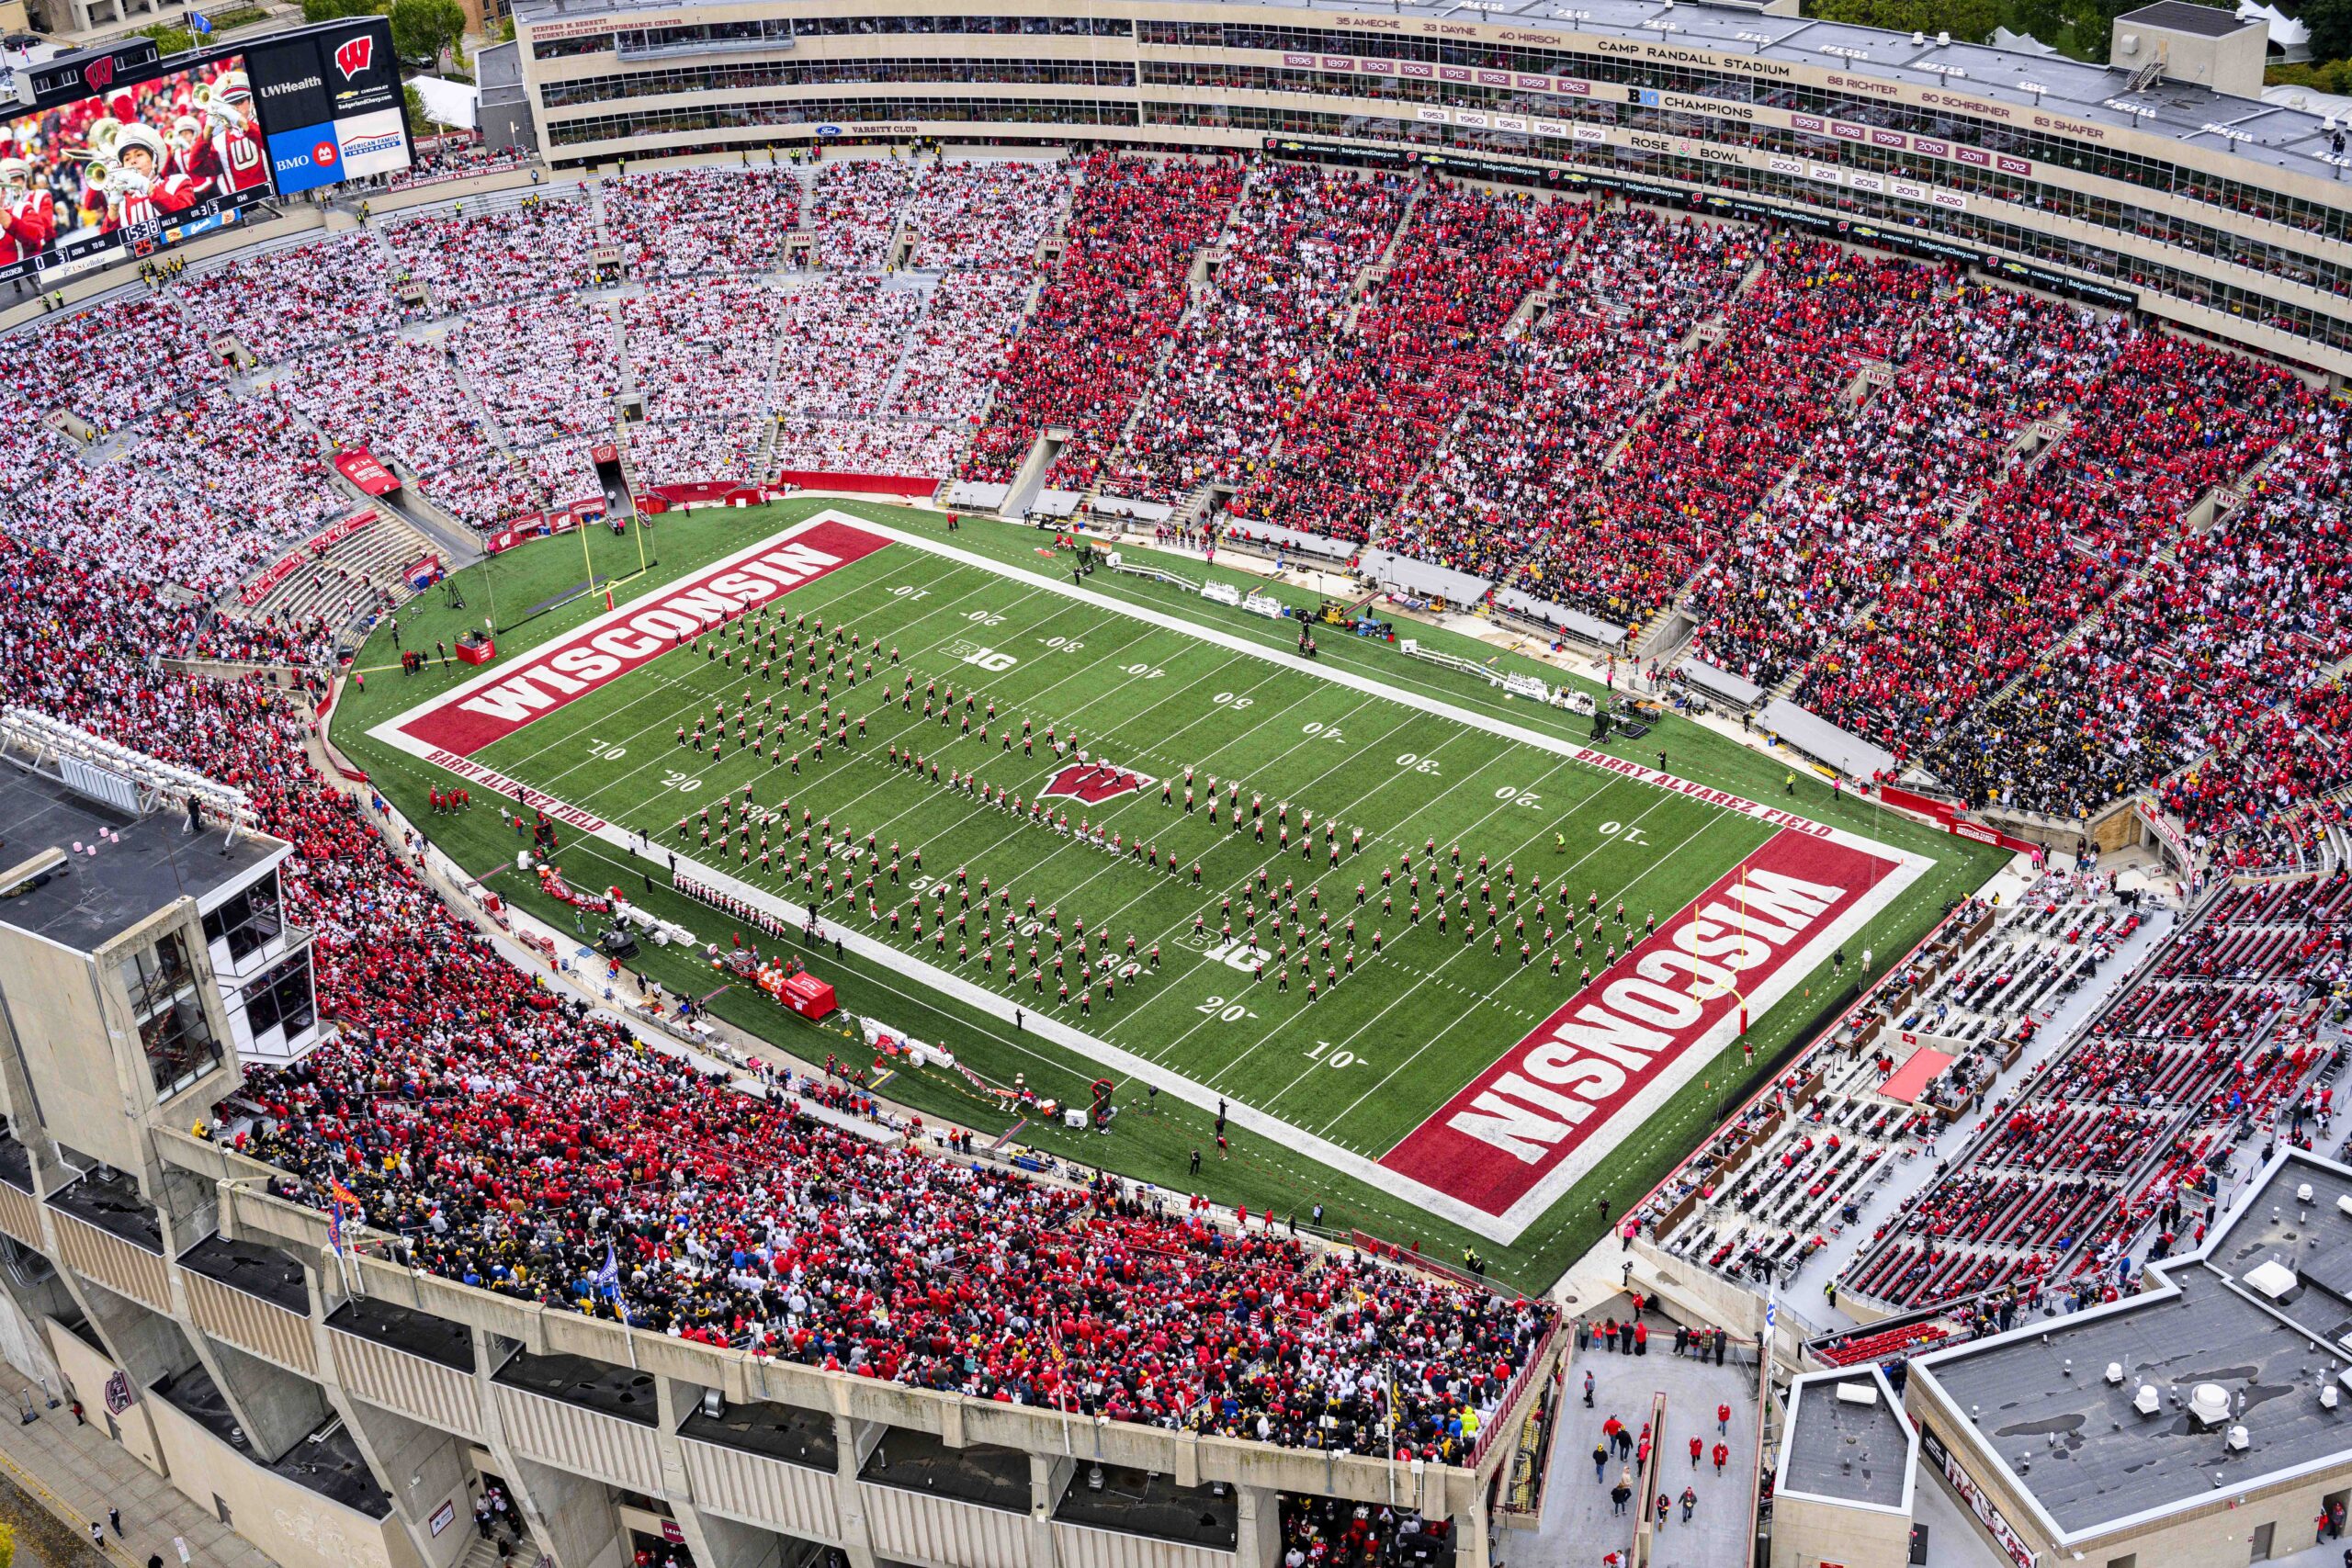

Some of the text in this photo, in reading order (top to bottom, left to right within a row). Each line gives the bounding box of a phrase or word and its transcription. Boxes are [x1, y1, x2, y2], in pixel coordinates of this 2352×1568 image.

[532, 24, 563, 33] STEPHEN
[575, 18, 607, 28] BENNETT
[533, 18, 683, 40] STUDENT-ATHLETE PERFORMANCE CENTER
[1352, 17, 1400, 29] AMECHE
[1423, 24, 1476, 36] 33 DAYNE
[1499, 32, 1561, 45] 40 HIRSCH
[1288, 56, 1311, 65] 1896
[1327, 60, 1350, 69] 1897
[1598, 41, 1790, 76] CAMP RANDALL STADIUM
[1367, 62, 1388, 72] 1901
[1404, 65, 1429, 74] 1906
[1444, 70, 1465, 79] 1912
[1482, 73, 1506, 83] 1952
[1521, 78, 1545, 88] 1959
[1826, 75, 1898, 96] 88 RICHTER
[361, 85, 389, 94] CHEVROLET
[1561, 82, 1586, 92] 1962
[338, 94, 392, 110] BadgerlandChevy.com
[1665, 96, 1753, 118] CHAMPIONS
[1922, 93, 2010, 118] 80 SCHREINER
[1422, 111, 1445, 120] 1953
[1460, 116, 1484, 125] 1960
[1498, 120, 1522, 130] 1963
[1538, 125, 1562, 134] 1994
[1795, 118, 1819, 130] 1993
[1836, 126, 1860, 137] 1998
[2034, 116, 2104, 139] 83 SHAFER
[1578, 130, 1602, 139] 1999
[1876, 133, 1902, 145] 1999
[344, 135, 400, 152] AMERICAN FAMILY
[1632, 137, 1744, 164] ROSE BOWL
[1917, 141, 1944, 153] 2010
[1341, 147, 1399, 160] BadgerlandChevy.com
[1962, 151, 1984, 163] 2011
[276, 154, 310, 172] BMO
[1448, 159, 1478, 168] CHEVROLET
[1482, 163, 1541, 176] BadgerlandChevy.com
[1771, 162, 1801, 174] 2000
[2001, 160, 2026, 172] 2012
[390, 183, 413, 192] ROGER
[413, 174, 455, 187] MANSUKHANI
[461, 169, 484, 178] FAMILY
[486, 164, 514, 175] TERRACE
[1815, 169, 1837, 180] 2011
[265, 183, 274, 195] 7
[1591, 178, 1622, 187] CHEVROLET
[1625, 183, 1684, 198] BadgerlandChevy.com
[1854, 177, 1879, 189] 2012
[237, 194, 249, 203] IOWA
[1895, 186, 1921, 197] 2013
[1935, 194, 1963, 206] 2020
[1735, 202, 1766, 213] CHEVROLET
[1770, 208, 1830, 227] BadgerlandChevy.com
[125, 220, 158, 241] 15:38
[71, 246, 85, 256] DOWN
[135, 240, 153, 255] 25
[1882, 233, 1913, 245] CHEVROLET
[1917, 240, 1980, 261] BadgerlandChevy.com
[34, 256, 45, 270] 0
[2030, 271, 2064, 283] CHEVROLET
[2068, 279, 2132, 303] BadgerlandChevy.com
[894, 585, 932, 602] 10
[967, 610, 1007, 626] 20
[458, 542, 843, 722] WISCONSIN
[1046, 637, 1086, 654] 30
[1127, 663, 1167, 680] 40
[1213, 692, 1255, 711] 50
[1302, 722, 1343, 740] 40
[587, 741, 627, 761] 10
[1396, 753, 1441, 773] 30
[661, 773, 703, 793] 20
[424, 750, 606, 832] BARRY ALVAREZ FIELD
[1494, 786, 1536, 807] 20
[1574, 749, 1834, 838] BARRY ALVAREZ FIELD
[1598, 820, 1649, 844] 10
[909, 874, 952, 899] 50
[1194, 996, 1248, 1023] 20
[1446, 868, 1848, 1166] WISCONSIN
[1303, 1040, 1356, 1068] 10
